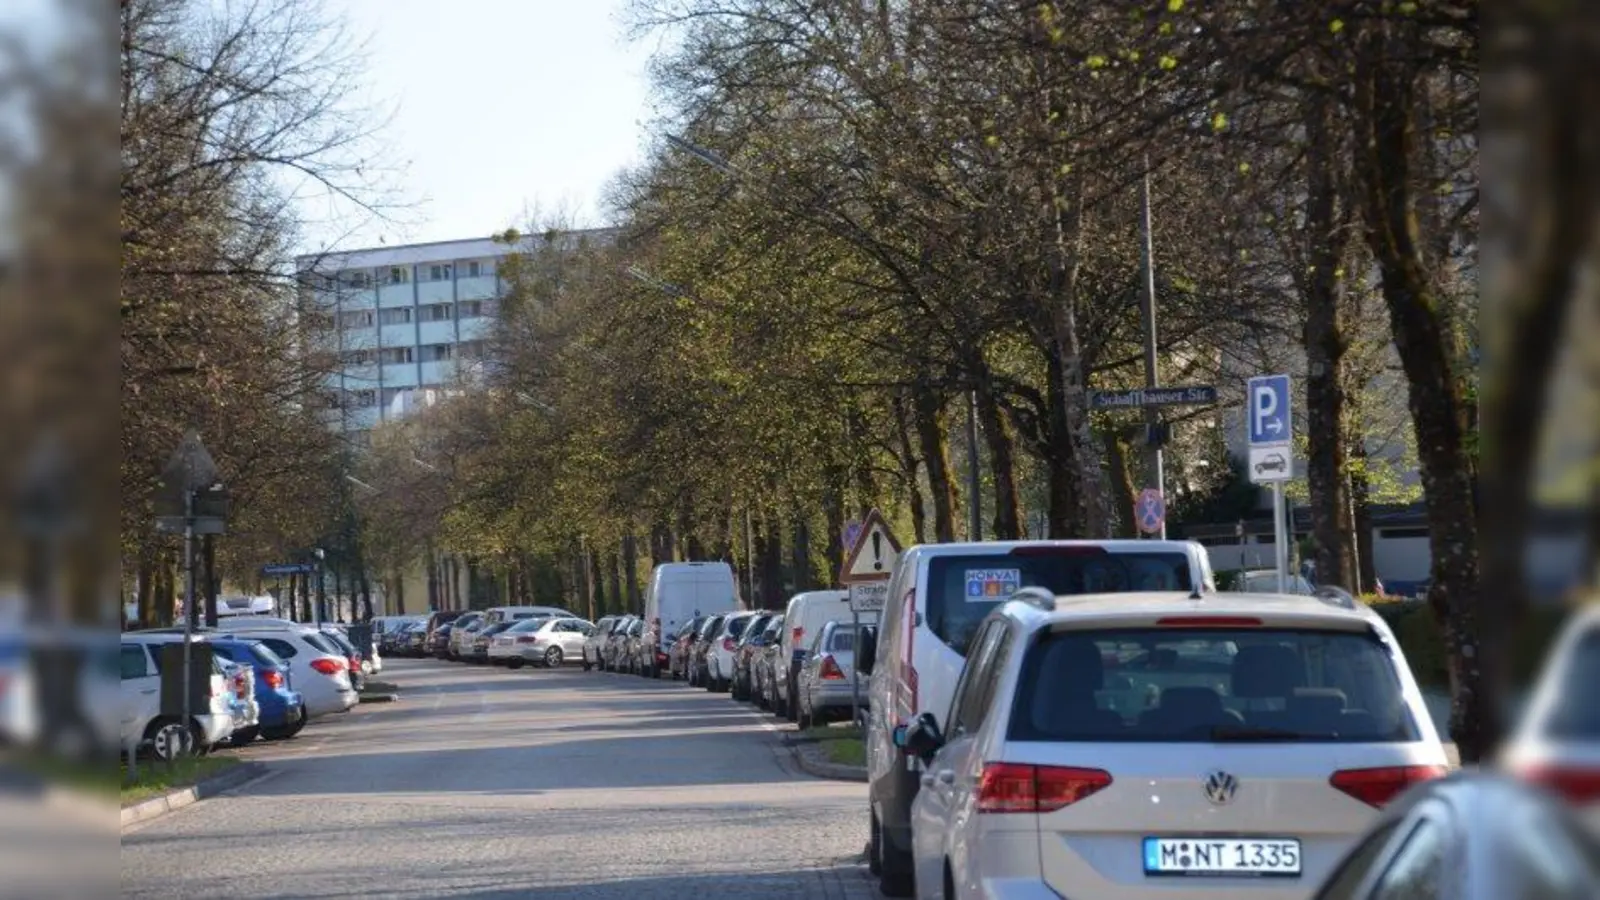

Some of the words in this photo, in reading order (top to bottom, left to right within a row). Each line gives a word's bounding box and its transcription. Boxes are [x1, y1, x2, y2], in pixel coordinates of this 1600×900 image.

[1255, 386, 1278, 435] P
[966, 571, 1019, 580] HORVAT
[1235, 843, 1297, 867] 1335
